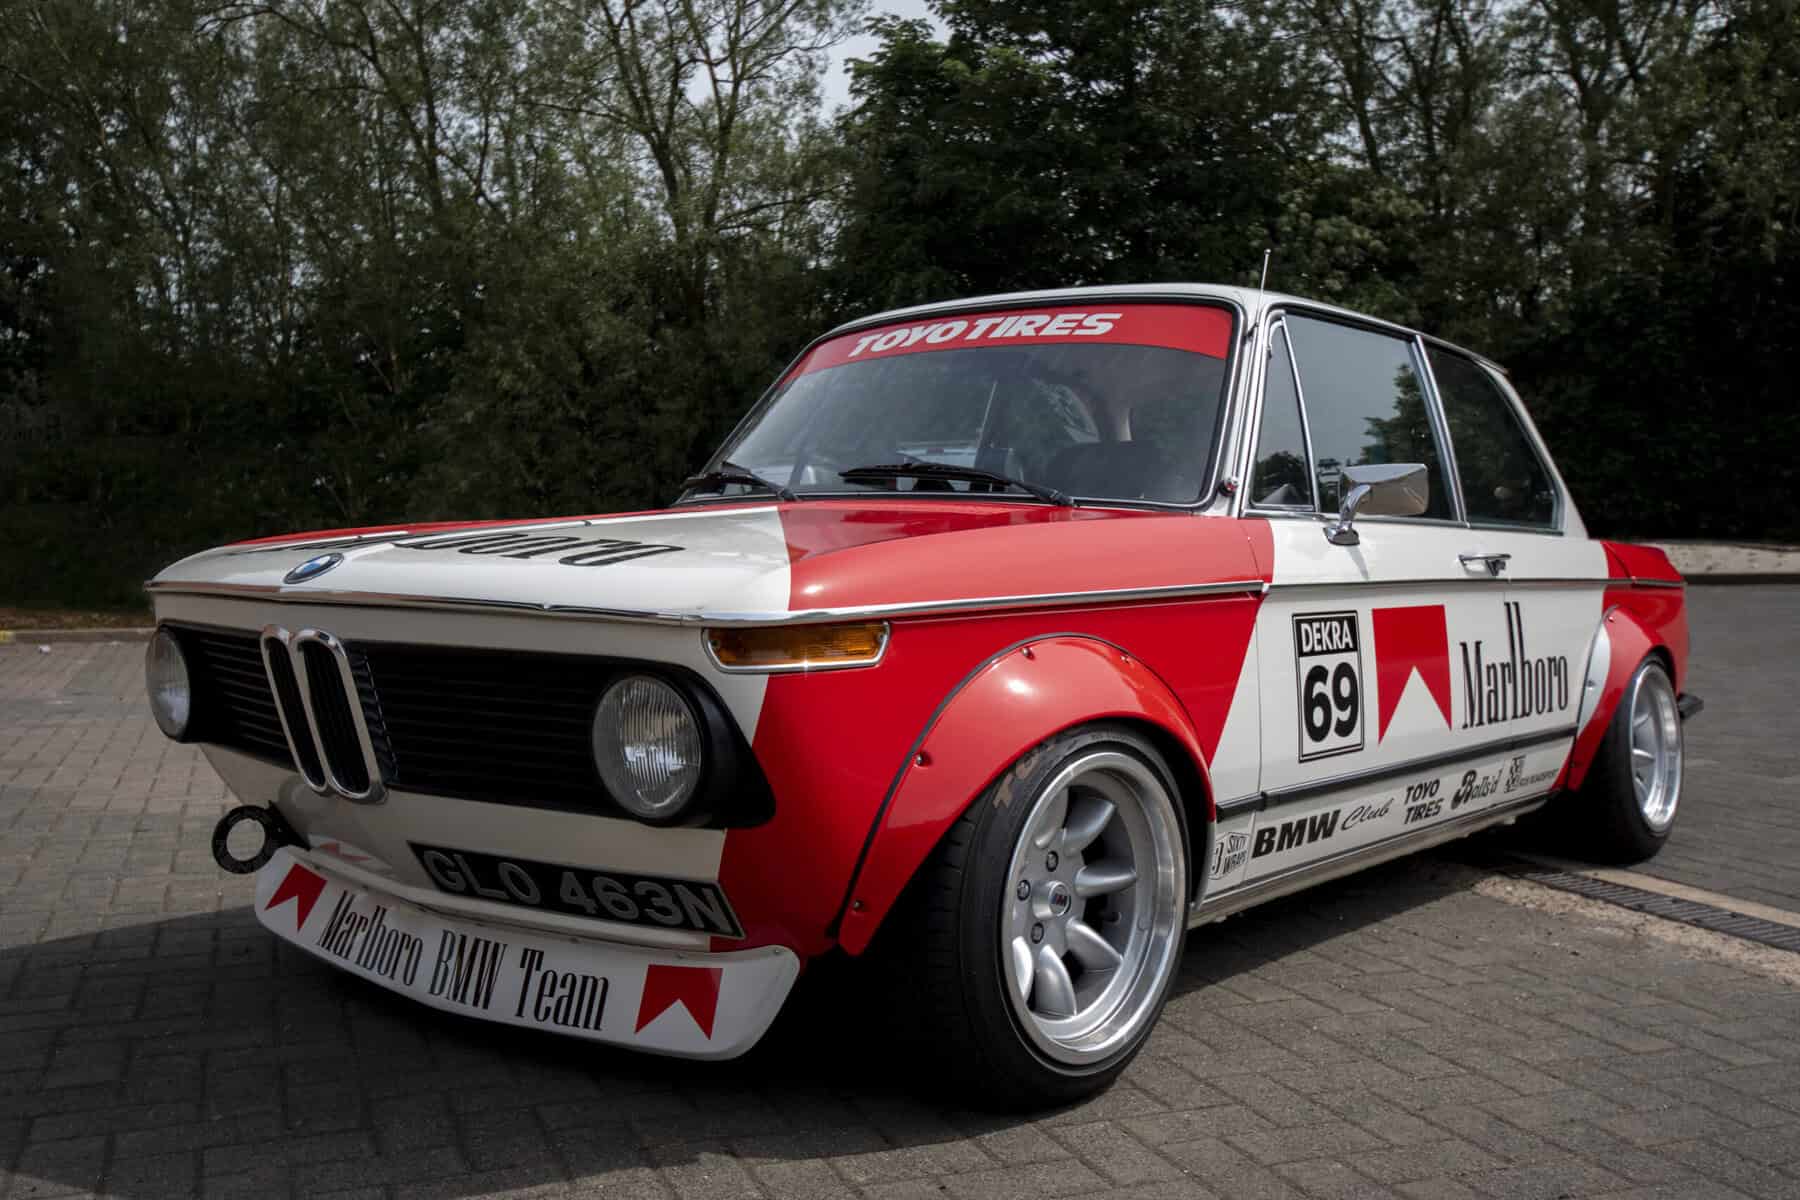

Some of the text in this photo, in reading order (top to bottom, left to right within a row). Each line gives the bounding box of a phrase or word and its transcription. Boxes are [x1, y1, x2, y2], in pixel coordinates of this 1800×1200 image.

[848, 313, 1123, 357] TOYO TIRES
[1300, 620, 1354, 653] DEKRA
[1459, 601, 1569, 729] Marlboro
[1303, 662, 1359, 742] 69
[1404, 778, 1441, 805] TOYO
[1404, 798, 1444, 824] TIRES
[1252, 798, 1395, 858] BMW Club
[423, 850, 735, 934] GLO 463N
[316, 890, 609, 1031] Marlboro BMW Team
